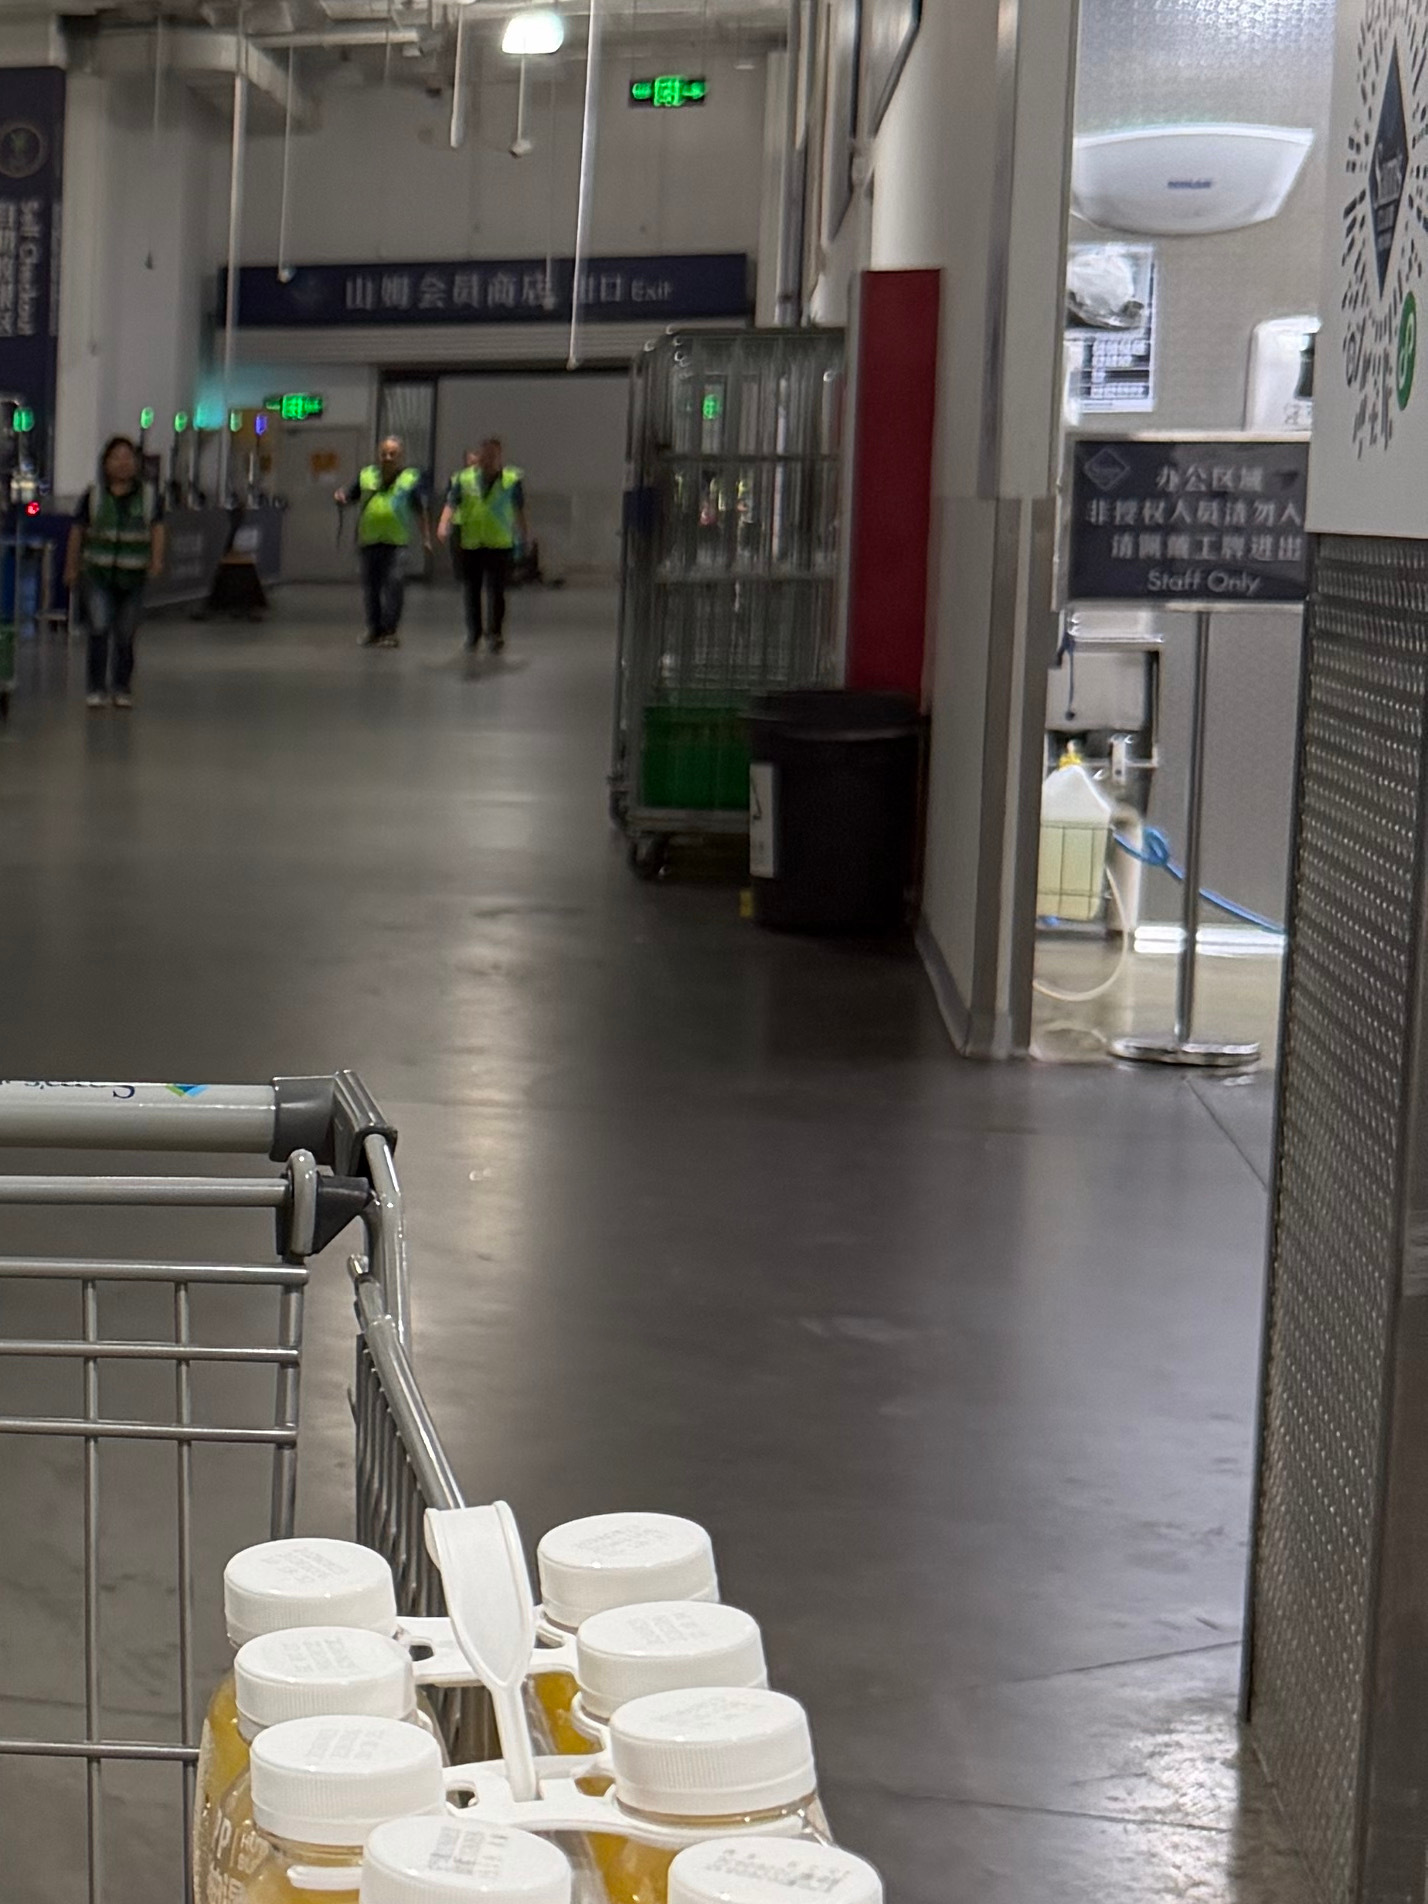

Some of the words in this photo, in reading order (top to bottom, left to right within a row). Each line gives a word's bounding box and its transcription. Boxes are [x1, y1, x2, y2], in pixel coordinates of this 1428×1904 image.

[345, 271, 550, 310] 山姆会员商店
[1156, 464, 1263, 492] 办公区域
[1087, 498, 1301, 527] 非授权人员请勿入
[1147, 569, 1200, 591] Staff
[1207, 569, 1261, 595] Only
